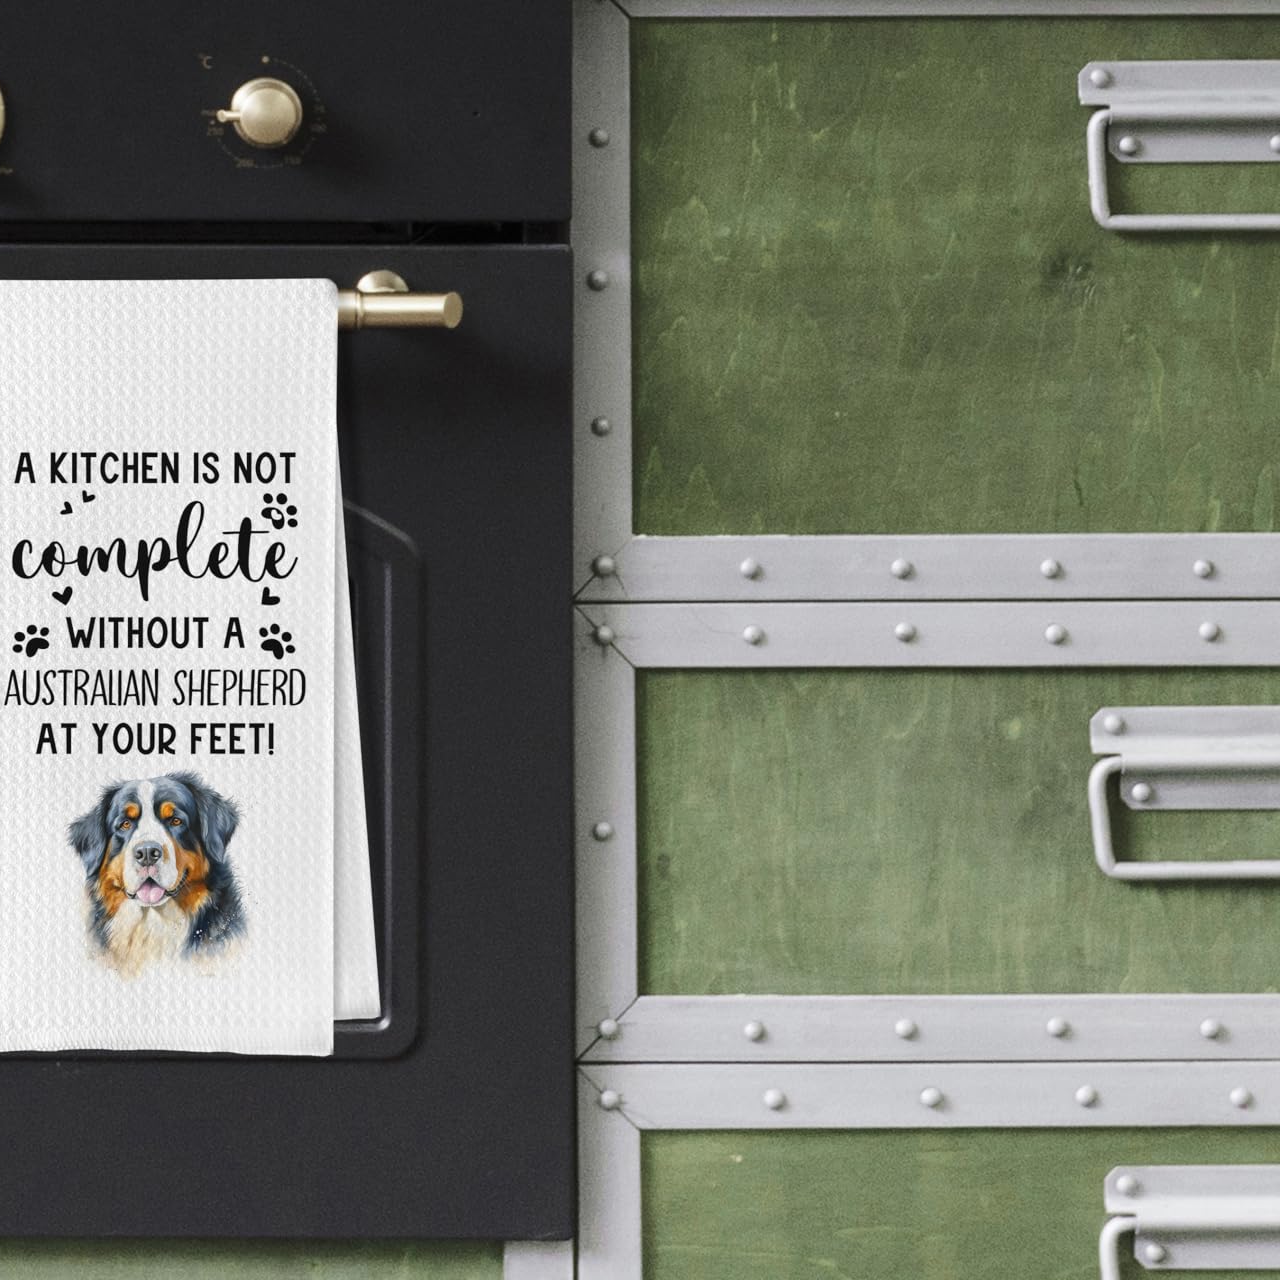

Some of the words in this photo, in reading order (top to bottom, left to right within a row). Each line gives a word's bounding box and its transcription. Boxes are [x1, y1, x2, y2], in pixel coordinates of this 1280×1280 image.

[14, 452, 36, 484] A
[50, 452, 180, 484] KITCHEN
[193, 452, 220, 484] IS
[234, 452, 297, 484] NOT
[12, 500, 298, 602] complete
[65, 616, 209, 649] WITHOUT
[223, 616, 245, 649] A
[4, 668, 159, 706] AUSTRALIAN
[172, 668, 307, 706] SHEPHERD
[35, 722, 78, 755] AT
[91, 722, 177, 755] YOUR
[190, 722, 275, 756] FEET!
